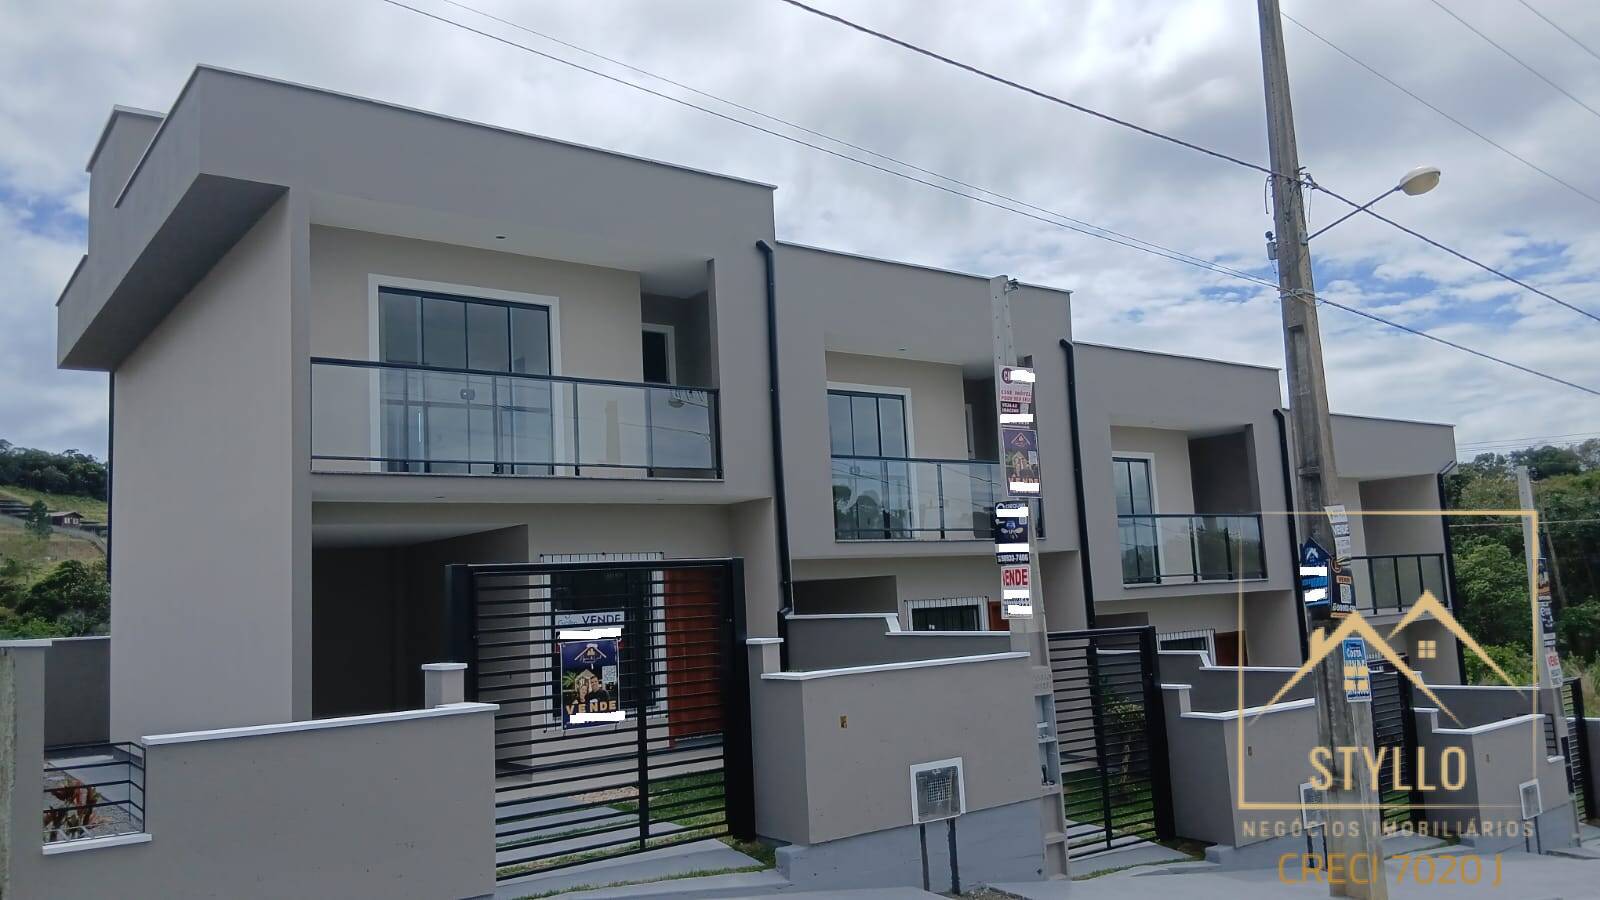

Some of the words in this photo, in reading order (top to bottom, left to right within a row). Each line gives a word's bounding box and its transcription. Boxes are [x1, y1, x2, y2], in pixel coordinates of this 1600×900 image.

[1002, 568, 1028, 586] VENDE
[582, 614, 621, 625] VENDE
[566, 700, 617, 715] VENDE
